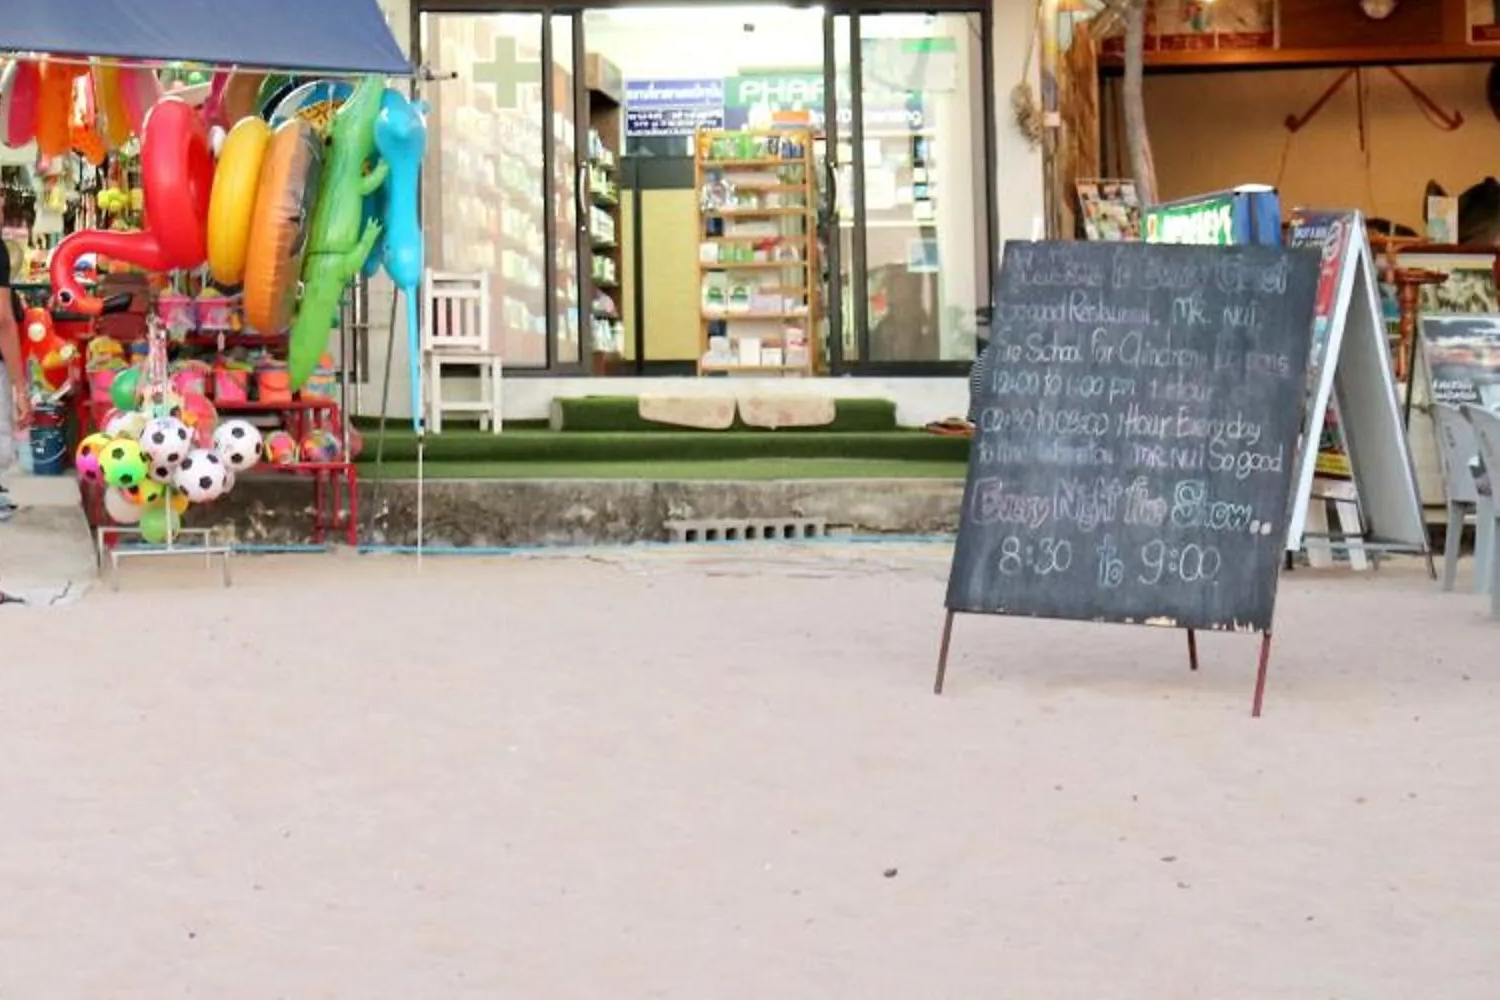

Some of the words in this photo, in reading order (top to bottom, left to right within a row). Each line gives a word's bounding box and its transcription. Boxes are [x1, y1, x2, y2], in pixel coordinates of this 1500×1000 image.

[999, 535, 1073, 575] 8:30
[1097, 534, 1125, 587] to
[1138, 538, 1222, 586] 9:00
